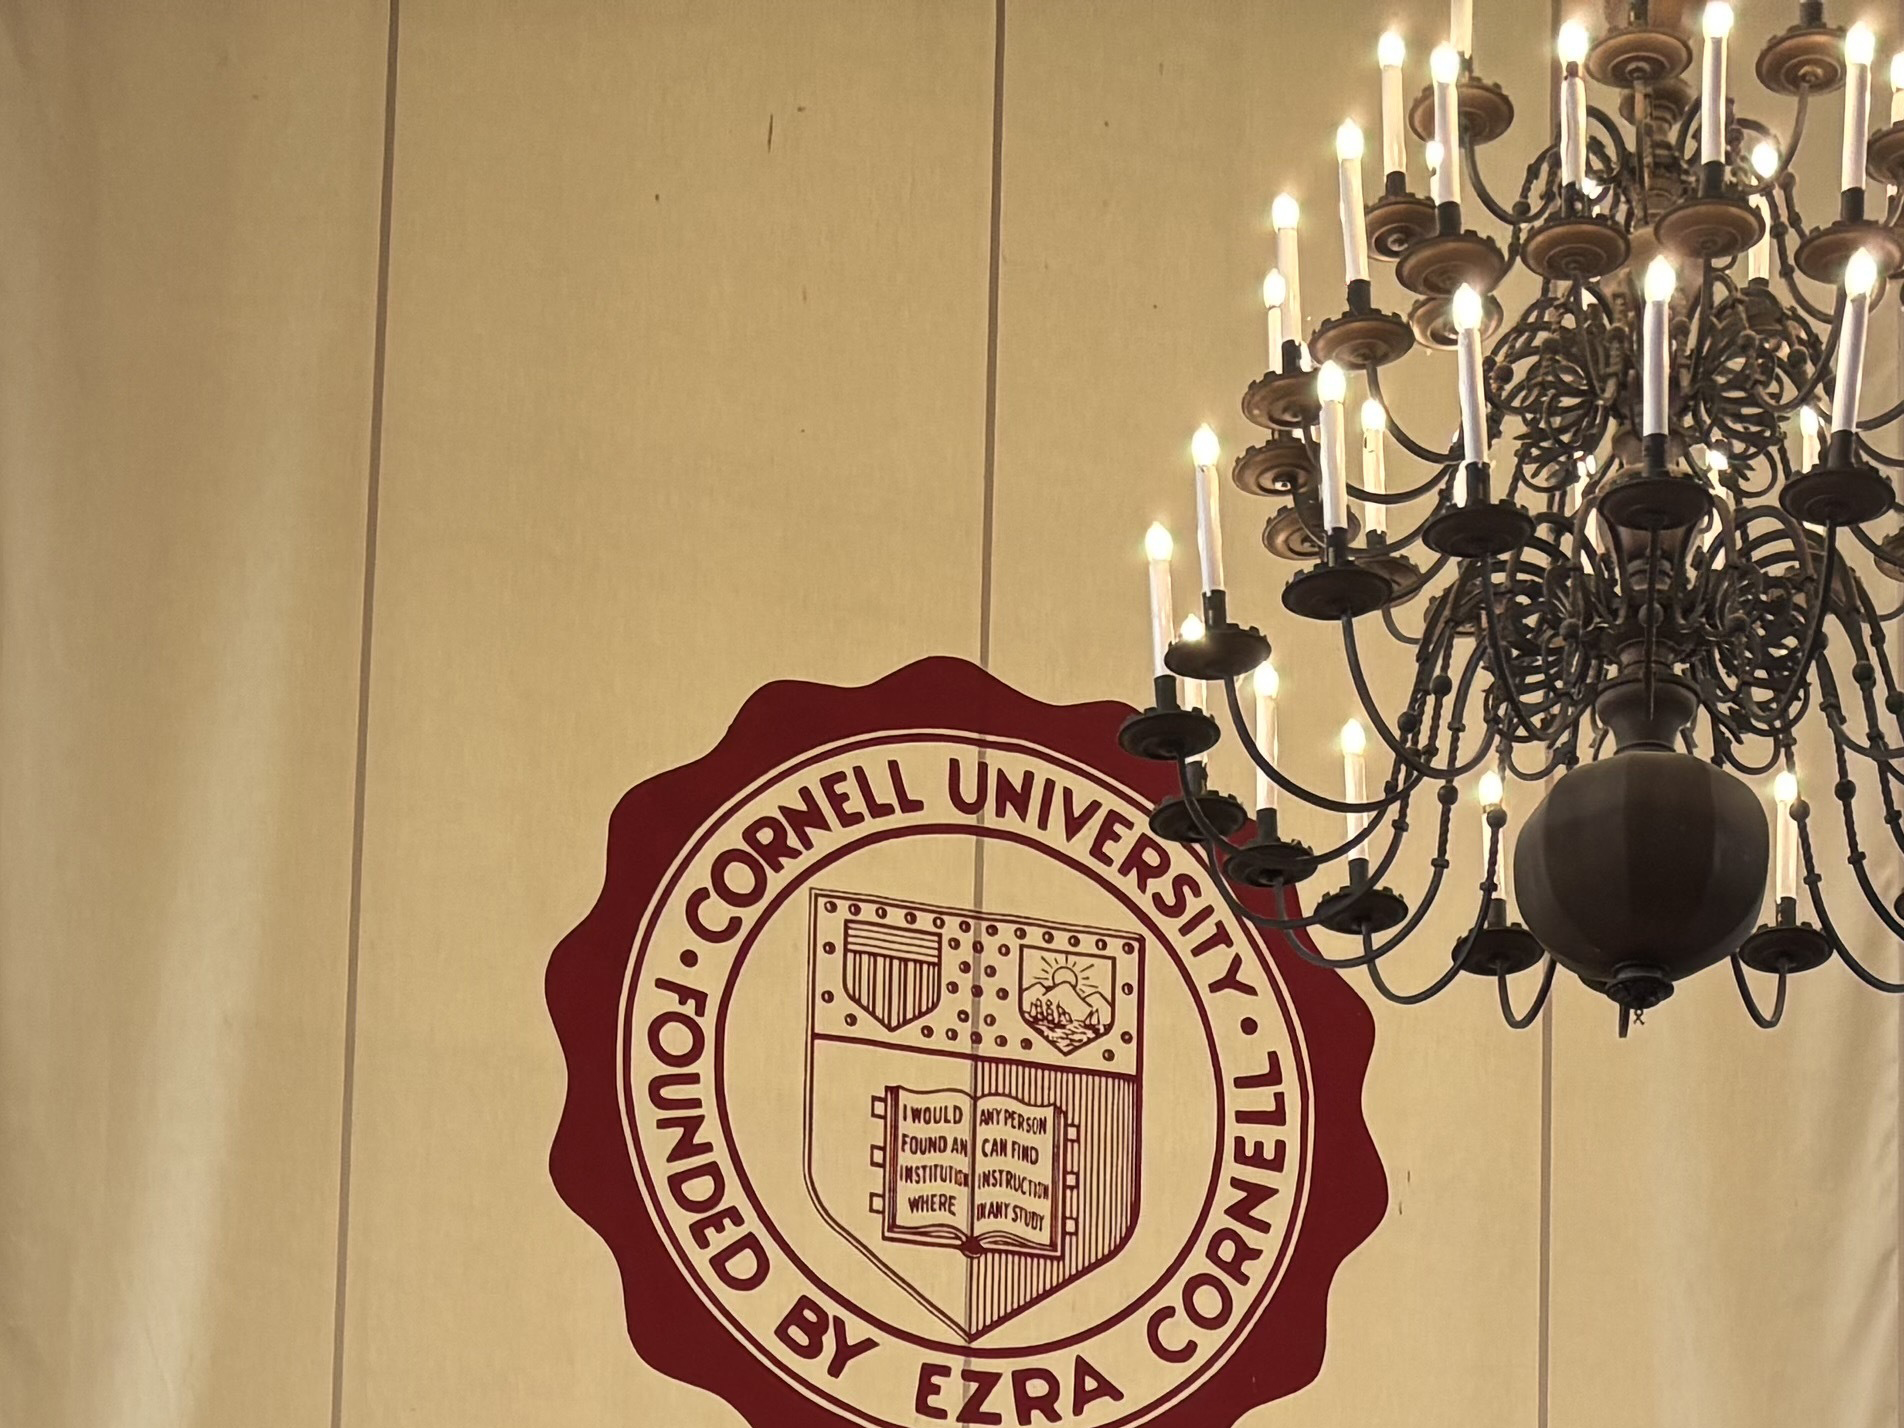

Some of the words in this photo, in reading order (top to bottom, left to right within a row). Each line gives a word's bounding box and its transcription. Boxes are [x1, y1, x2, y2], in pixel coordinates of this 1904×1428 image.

[685, 759, 924, 944] CORNELL
[948, 758, 1260, 997] UNIVERSITY
[910, 1104, 964, 1125] WOULD
[979, 1108, 1002, 1127] ANY
[1003, 1109, 1047, 1135] PERSON
[901, 1133, 948, 1155] FOUND
[951, 1137, 968, 1157] AN
[981, 1138, 1007, 1158] CAN
[1011, 1140, 1039, 1165] FIND
[899, 1164, 969, 1187] INSTITUTION
[978, 1169, 1049, 1200] INSTRUCTION
[647, 976, 771, 1292] FOUNDED
[774, 1293, 879, 1380] BY
[914, 1354, 1125, 1427] EZRA
[1145, 1050, 1287, 1364] CORNELL
[908, 1193, 957, 1217] WHERE
[987, 1201, 1010, 1219] ANY
[1011, 1204, 1045, 1232] STUDY
